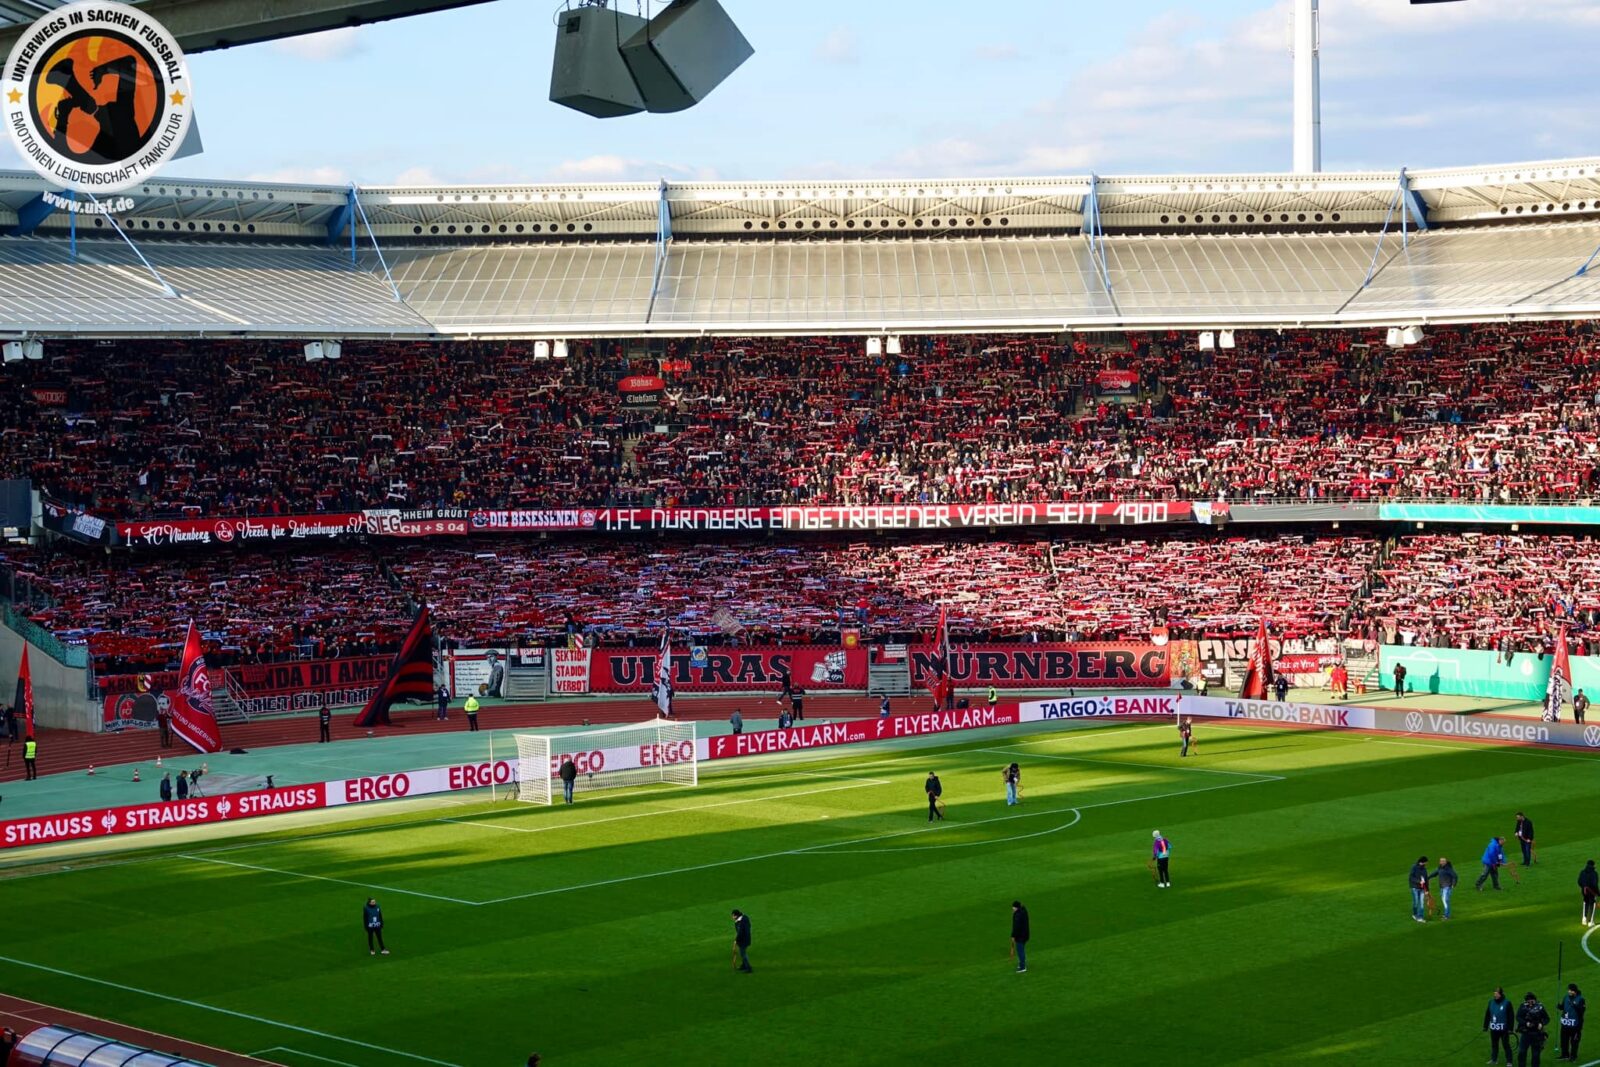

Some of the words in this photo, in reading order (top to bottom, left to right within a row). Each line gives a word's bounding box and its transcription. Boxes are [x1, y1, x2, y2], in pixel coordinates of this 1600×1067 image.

[367, 514, 401, 534] SIEG
[435, 523, 444, 532] S
[447, 523, 465, 532] 04
[489, 511, 508, 528] DIE
[510, 510, 579, 527] BESESSENEN
[651, 508, 763, 530] NÜRNBERG
[769, 505, 951, 529] EINGETRAGENER
[957, 503, 1036, 525] VEREIN
[1046, 503, 1104, 524] SEIT
[1113, 502, 1168, 523] 1900
[141, 526, 165, 546] FC
[164, 525, 211, 544] Nürnberg
[236, 520, 269, 539] Verein
[271, 524, 286, 539] für
[555, 649, 587, 662] SEKTION
[310, 663, 332, 686] DI
[555, 665, 587, 677] STADION
[556, 680, 587, 692] VERBOT
[1429, 714, 1549, 742] Volkswagen
[639, 740, 694, 767] ERGO
[448, 761, 510, 790] ERGO
[344, 773, 410, 803] ERGO
[239, 788, 317, 814] STRAUSS
[125, 802, 209, 828] STRAUSS
[5, 815, 93, 843] STRAUSS
